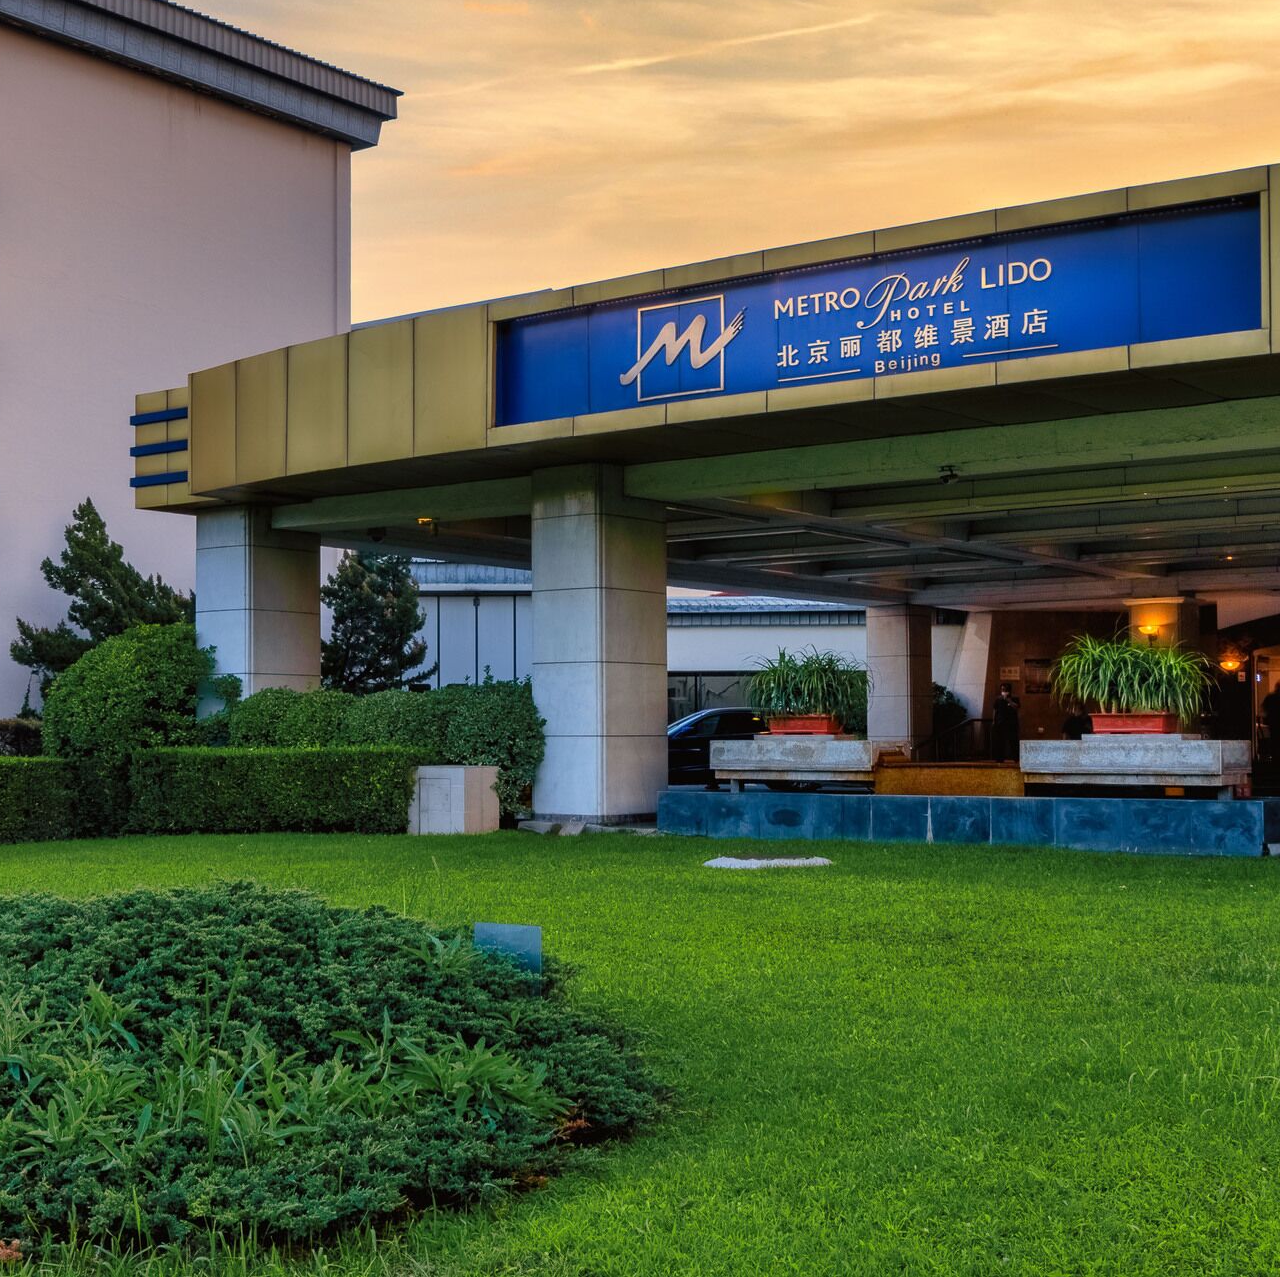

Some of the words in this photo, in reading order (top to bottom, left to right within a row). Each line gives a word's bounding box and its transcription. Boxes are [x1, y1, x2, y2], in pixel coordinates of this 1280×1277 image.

[773, 287, 861, 319] METRO
[856, 256, 970, 330] Park
[980, 258, 1053, 290] LIDO
[890, 300, 971, 322] HOTEL
[776, 308, 1049, 367] 北京丽都维景酒店
[874, 351, 941, 374] Beijing
